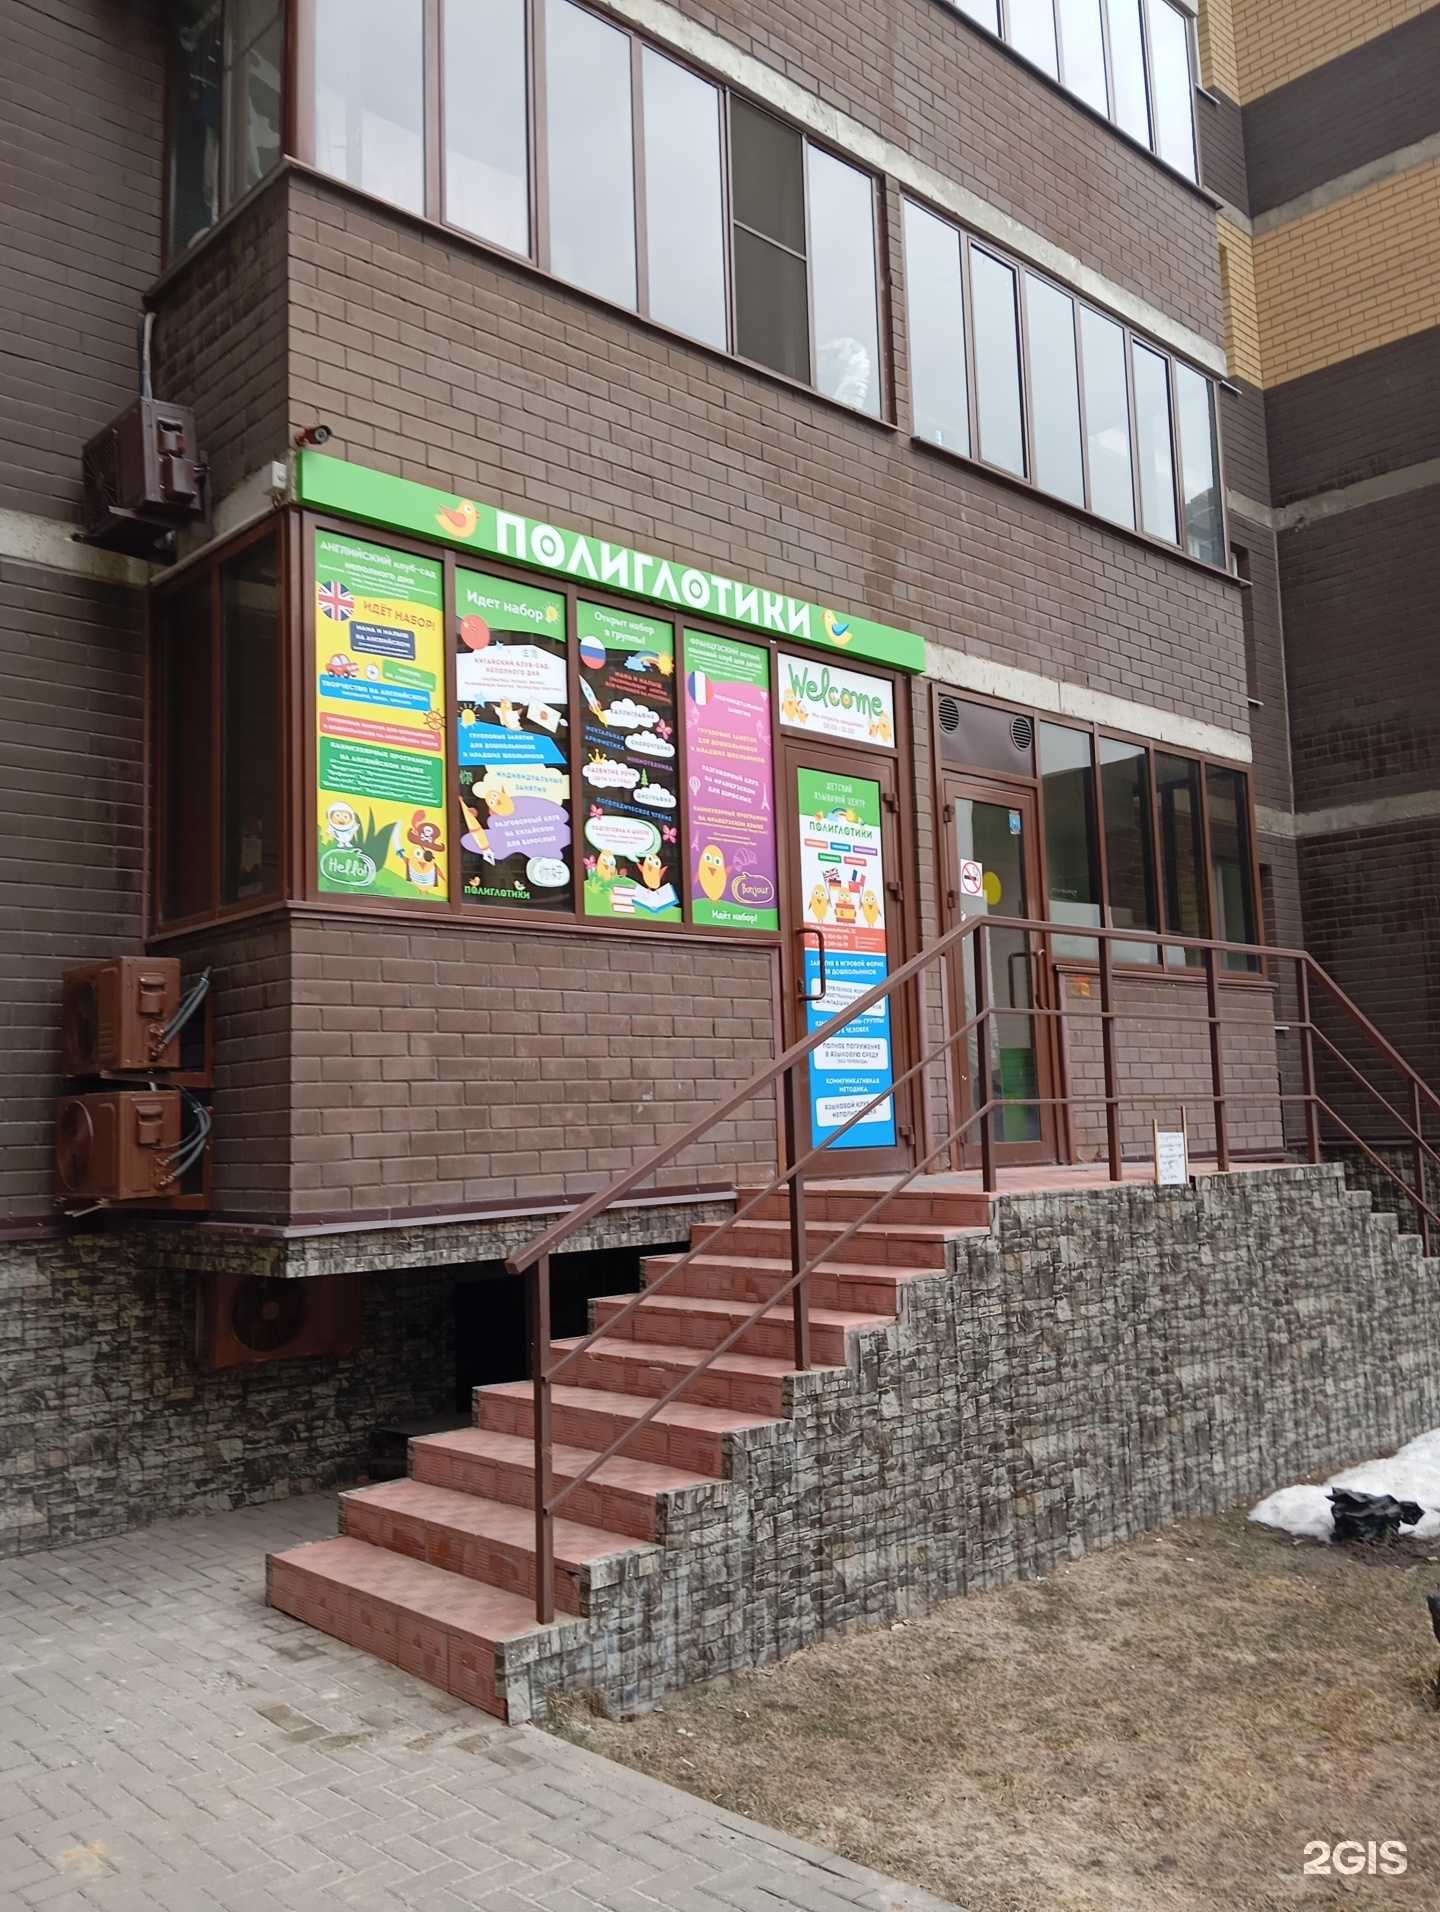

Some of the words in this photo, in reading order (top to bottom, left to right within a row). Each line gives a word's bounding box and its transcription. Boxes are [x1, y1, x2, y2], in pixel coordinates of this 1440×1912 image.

[496, 509, 812, 638] ПОЛИГЛОТИКИ
[467, 590, 501, 608] Идет
[504, 602, 544, 623] набор
[395, 611, 436, 631] НАБОР!
[788, 664, 883, 720] Welcome
[810, 821, 873, 839] ПОЛИГЛОТИКИ
[464, 886, 530, 899] ПОЛИГЛОТИКИ
